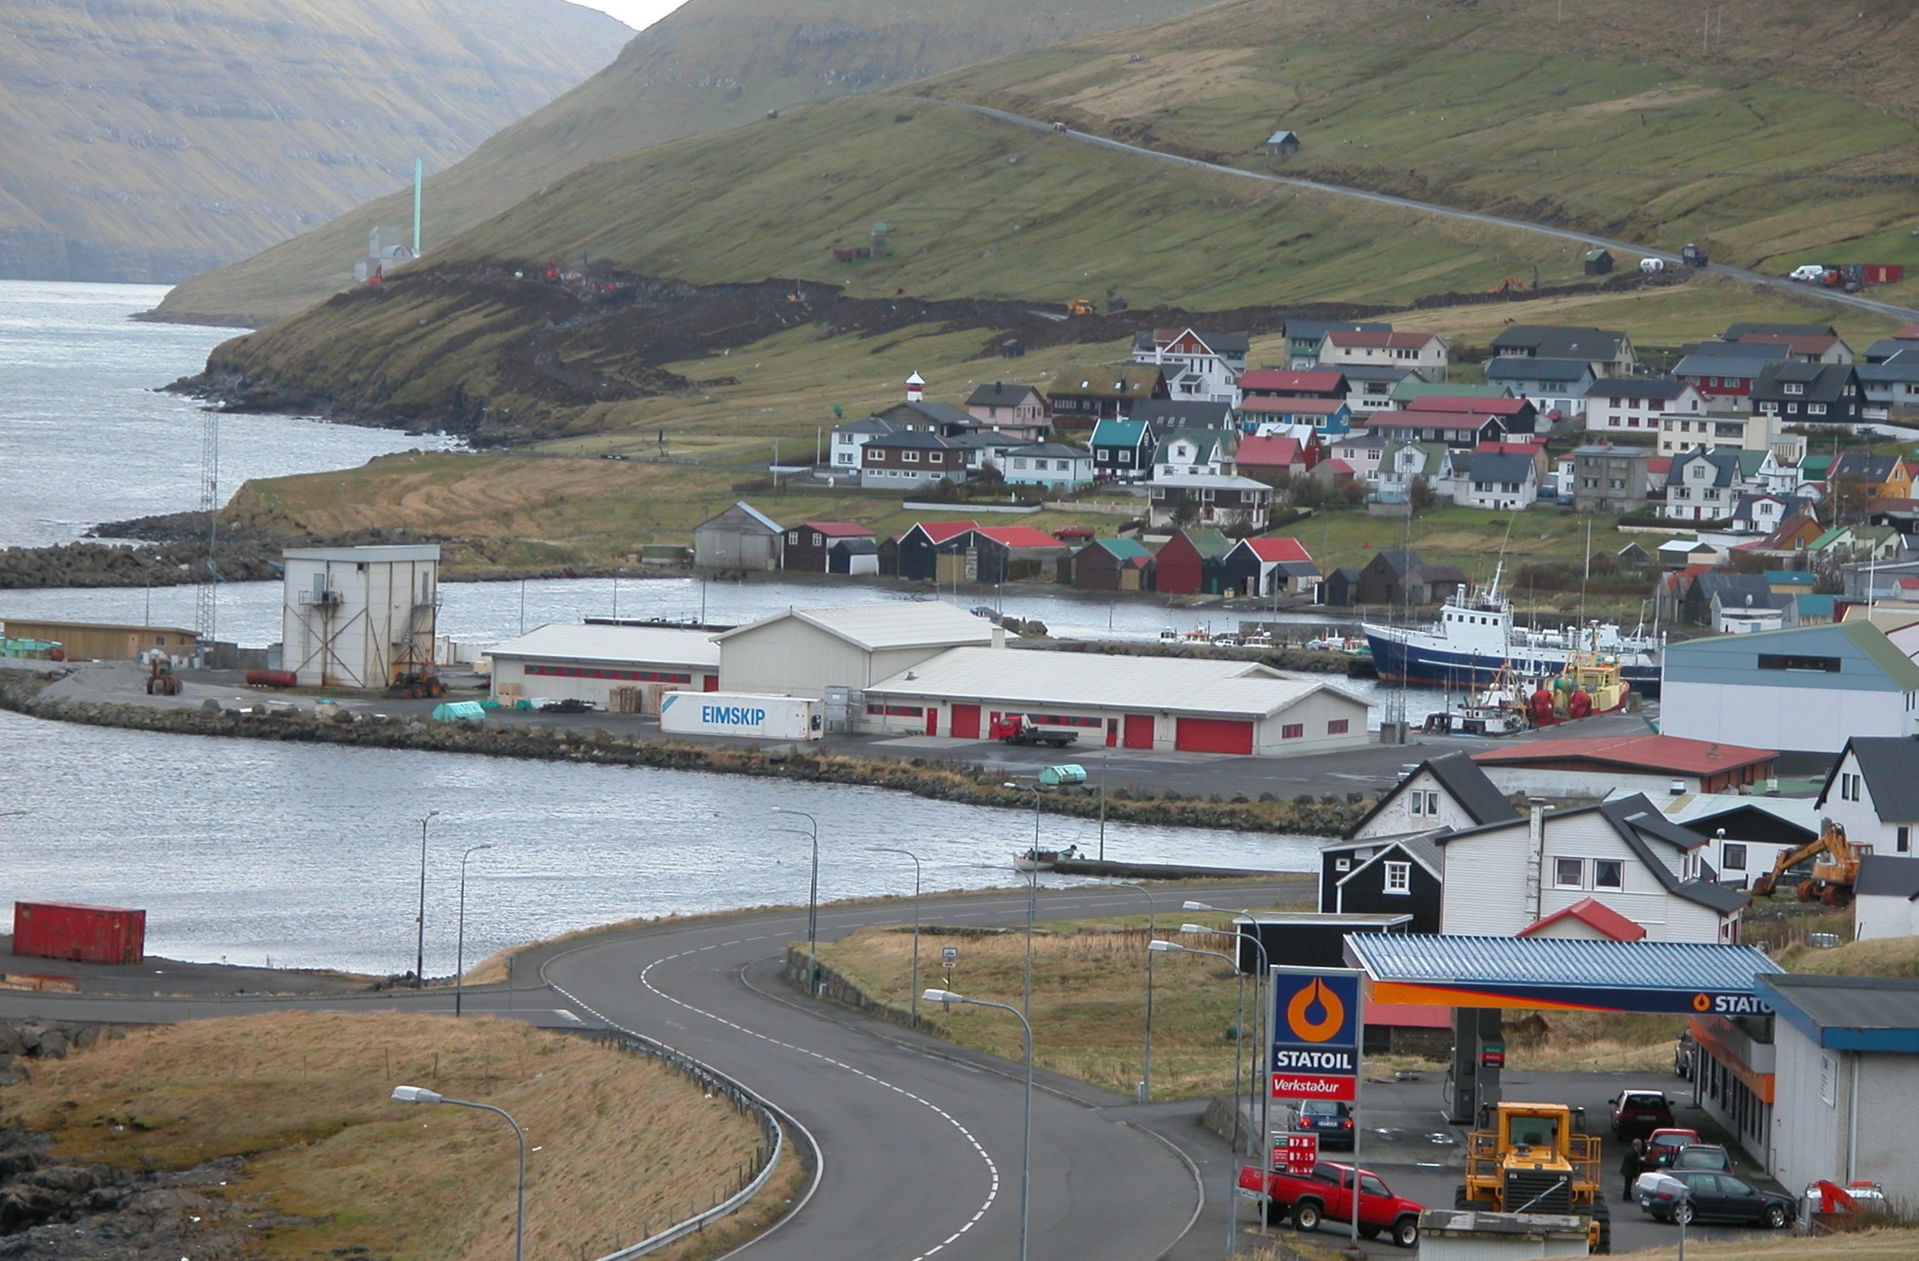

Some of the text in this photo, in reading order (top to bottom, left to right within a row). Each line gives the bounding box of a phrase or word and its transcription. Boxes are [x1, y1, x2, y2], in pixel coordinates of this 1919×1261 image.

[702, 705, 766, 726] EIMSKIP
[1277, 1051, 1352, 1069] STATOIL
[1274, 1079, 1339, 1093] Verkstaður
